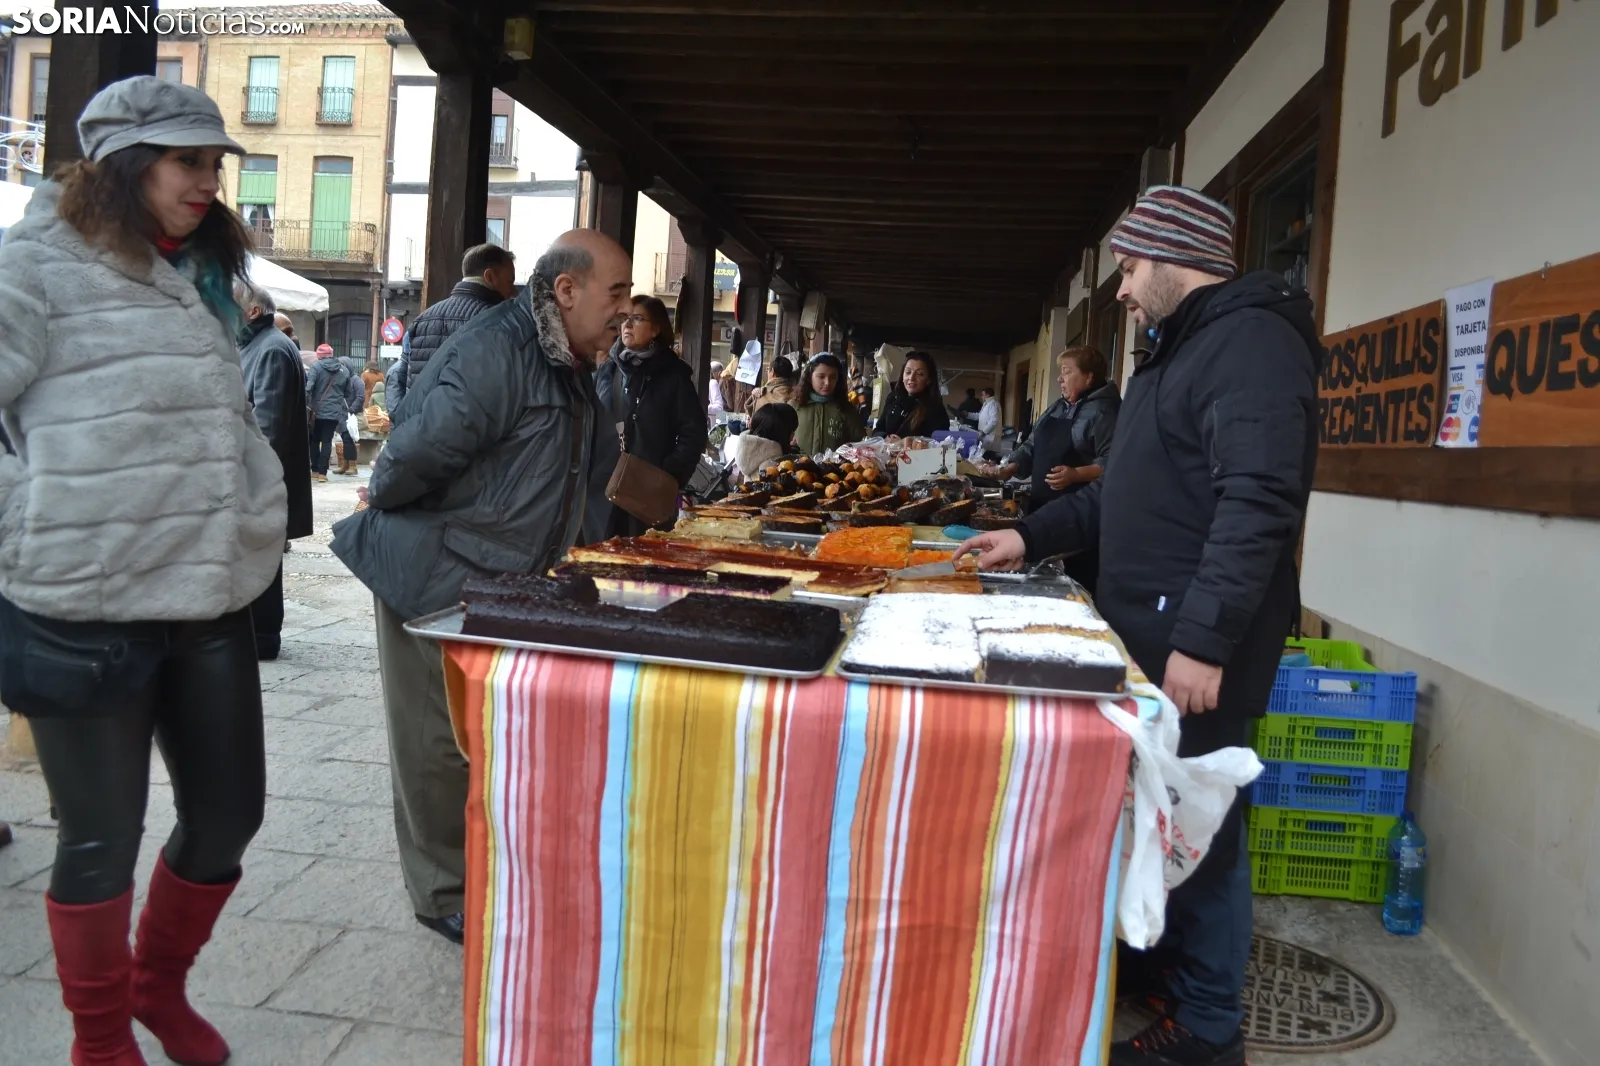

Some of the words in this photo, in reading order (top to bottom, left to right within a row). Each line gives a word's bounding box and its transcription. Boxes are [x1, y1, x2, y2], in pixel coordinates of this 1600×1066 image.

[1455, 301, 1472, 313] PAGO
[1473, 298, 1486, 310] CON
[1456, 320, 1486, 336] TARJETA
[1454, 344, 1487, 358] DISPONIBL
[1452, 372, 1463, 383] VISA
